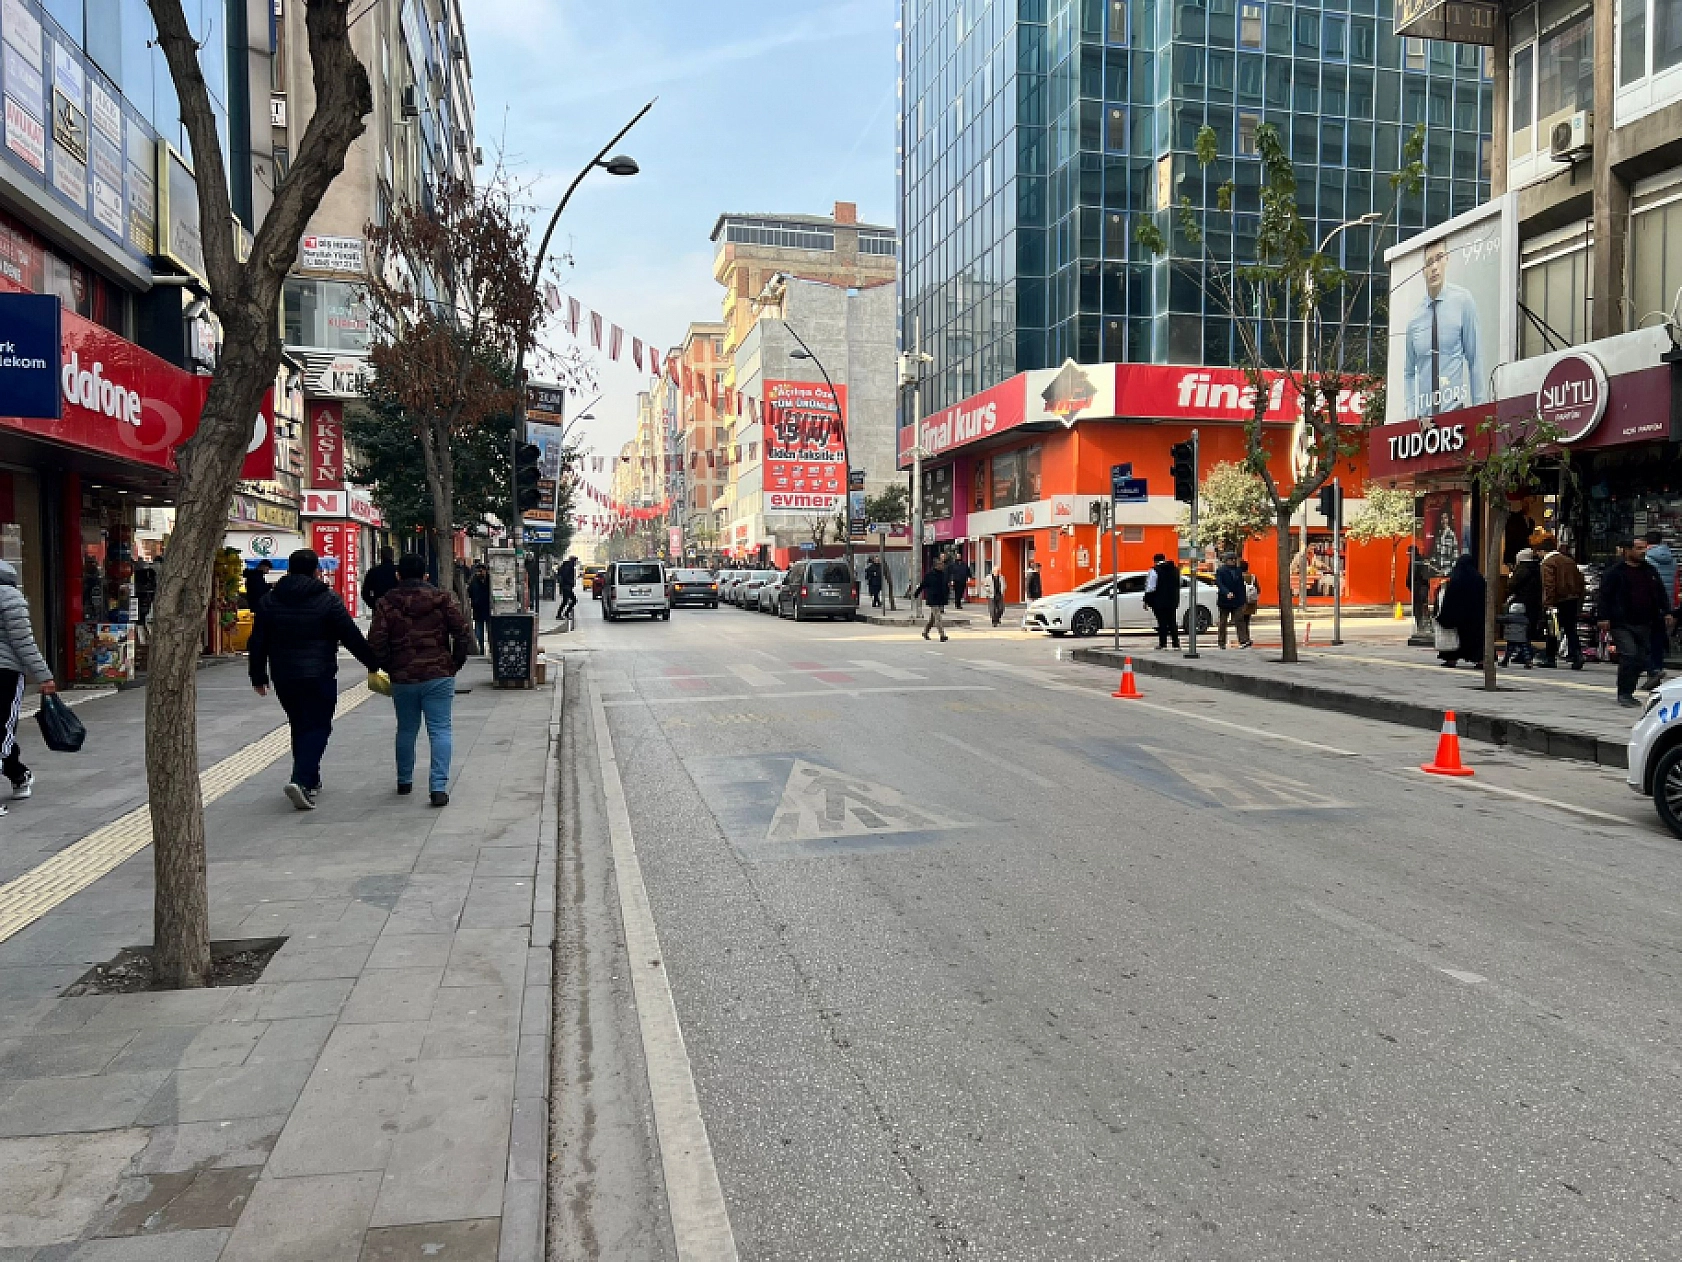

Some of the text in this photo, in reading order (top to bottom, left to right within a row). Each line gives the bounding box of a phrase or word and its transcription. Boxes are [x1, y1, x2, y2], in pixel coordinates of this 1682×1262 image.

[0, 341, 15, 353] rk
[0, 355, 47, 368] lekom
[61, 350, 142, 426] dafone
[1177, 372, 1284, 411] final
[920, 400, 996, 451] final kurs
[1387, 424, 1464, 461] TUDORS
[770, 494, 832, 507] evmer
